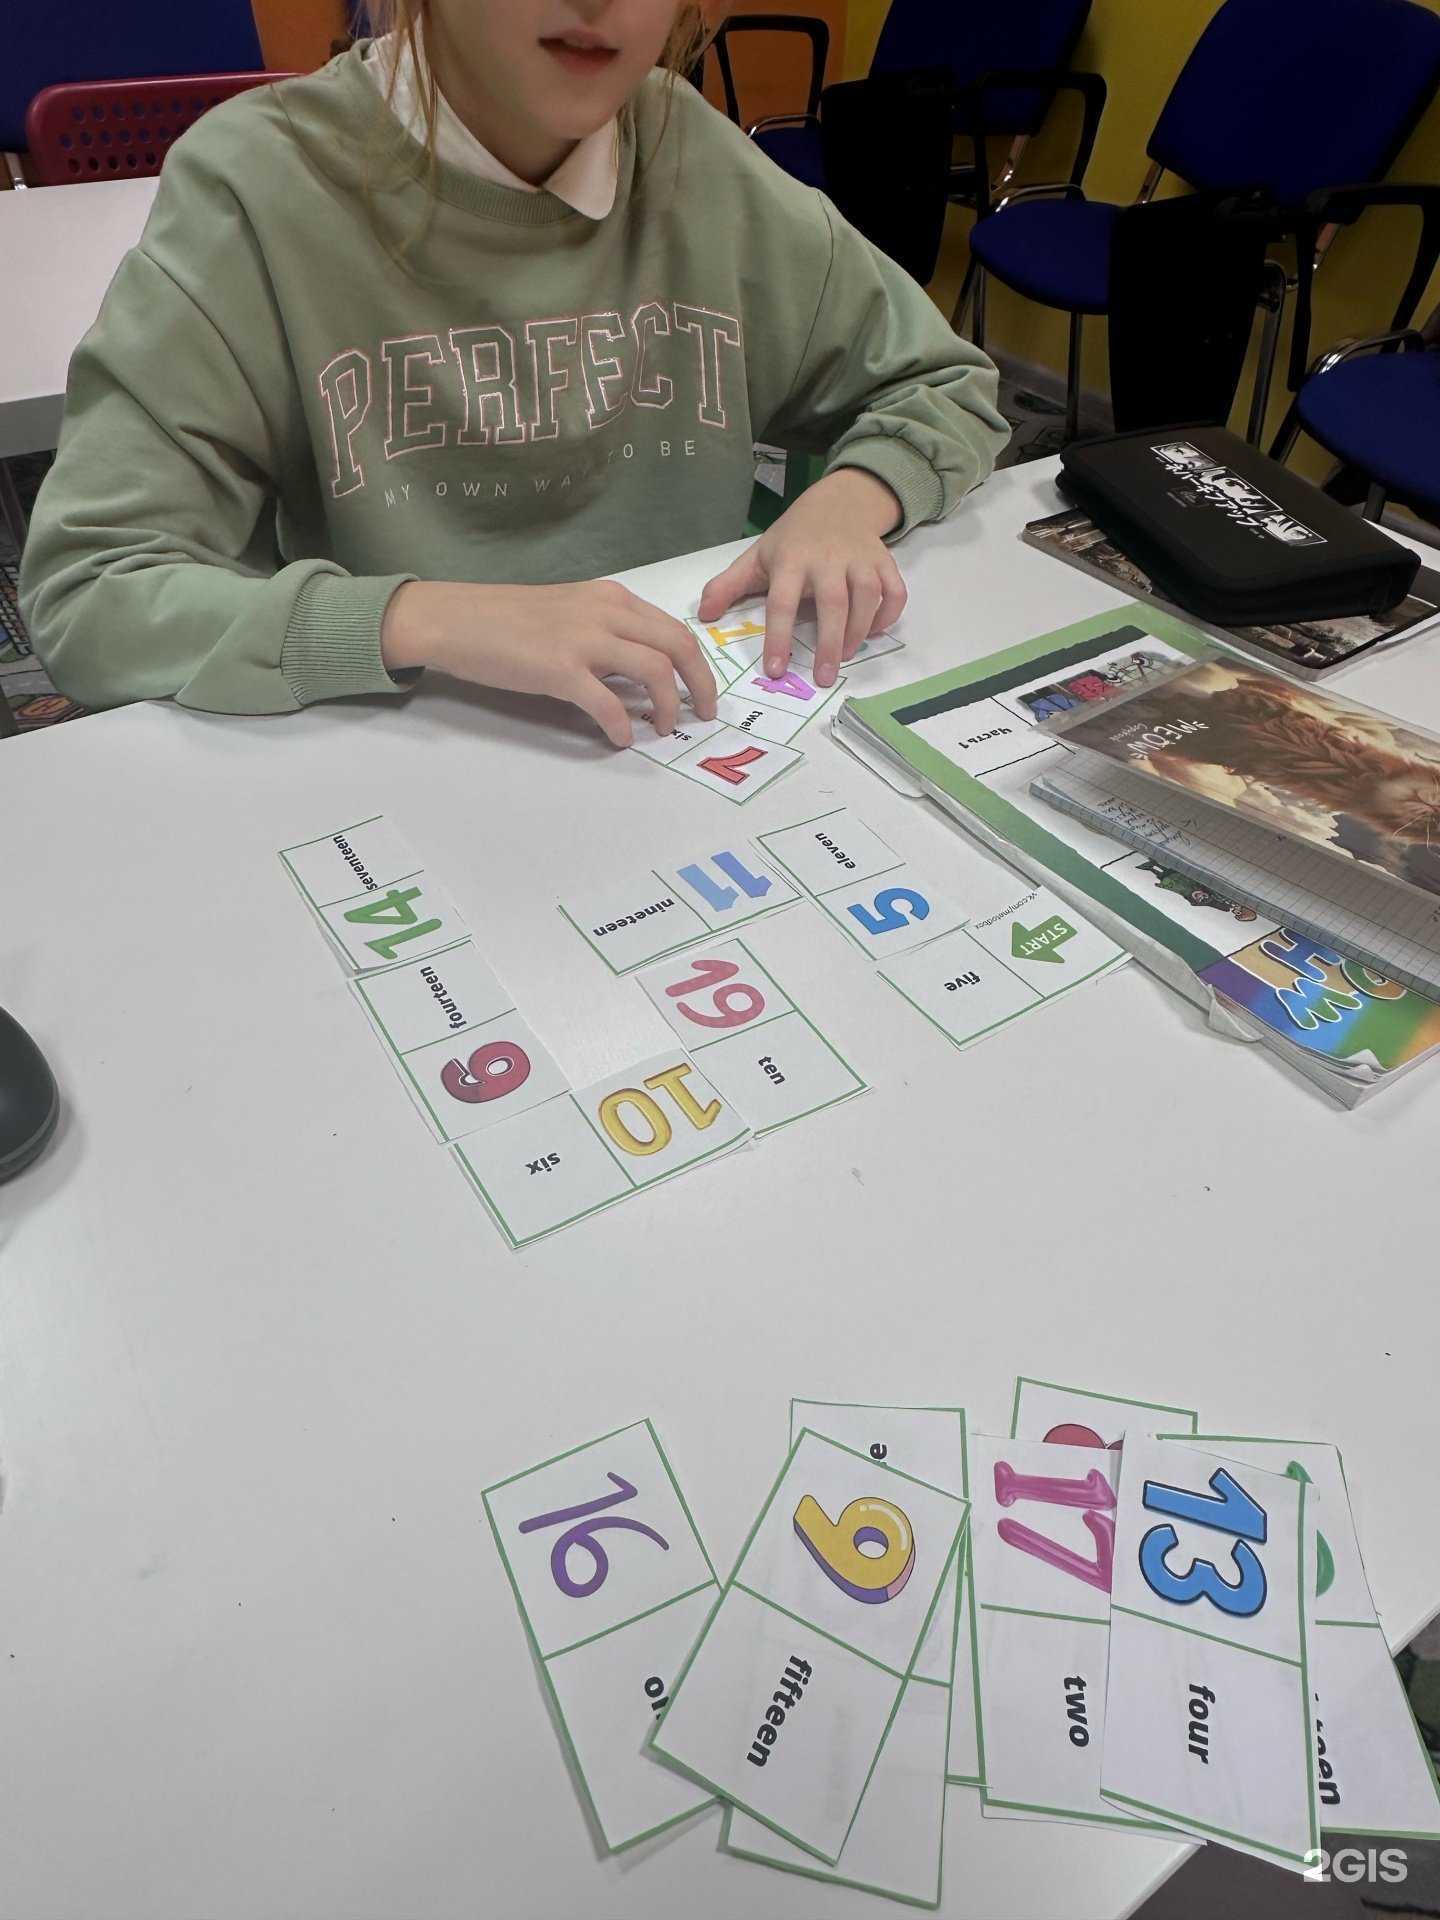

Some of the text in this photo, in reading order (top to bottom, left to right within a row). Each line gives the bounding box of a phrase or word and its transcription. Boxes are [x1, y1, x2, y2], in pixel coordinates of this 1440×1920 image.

[319, 302, 741, 498] PERFECT
[384, 484, 410, 508] MY
[435, 481, 508, 498] OWN
[660, 440, 696, 457] BE
[751, 670, 817, 701] 4
[739, 709, 764, 732] twel
[696, 745, 768, 786] 7
[332, 834, 379, 891] seventeen
[675, 850, 774, 913] 11
[815, 831, 857, 871] eleven
[343, 886, 443, 960] 14
[592, 897, 676, 938] nineteen
[845, 886, 931, 936] 5
[1021, 922, 1069, 957] START
[419, 965, 468, 1030] fourteen
[664, 958, 766, 1029] 19
[943, 970, 981, 993] five
[757, 1055, 786, 1086] ten
[597, 1061, 723, 1157] 10
[525, 1151, 561, 1176] six
[518, 1470, 670, 1599] 16
[993, 1460, 1118, 1595] 17
[1138, 1467, 1269, 1619] 13
[745, 1655, 813, 1768] fifteen
[1063, 1674, 1090, 1748] two
[1187, 1683, 1217, 1766] four
